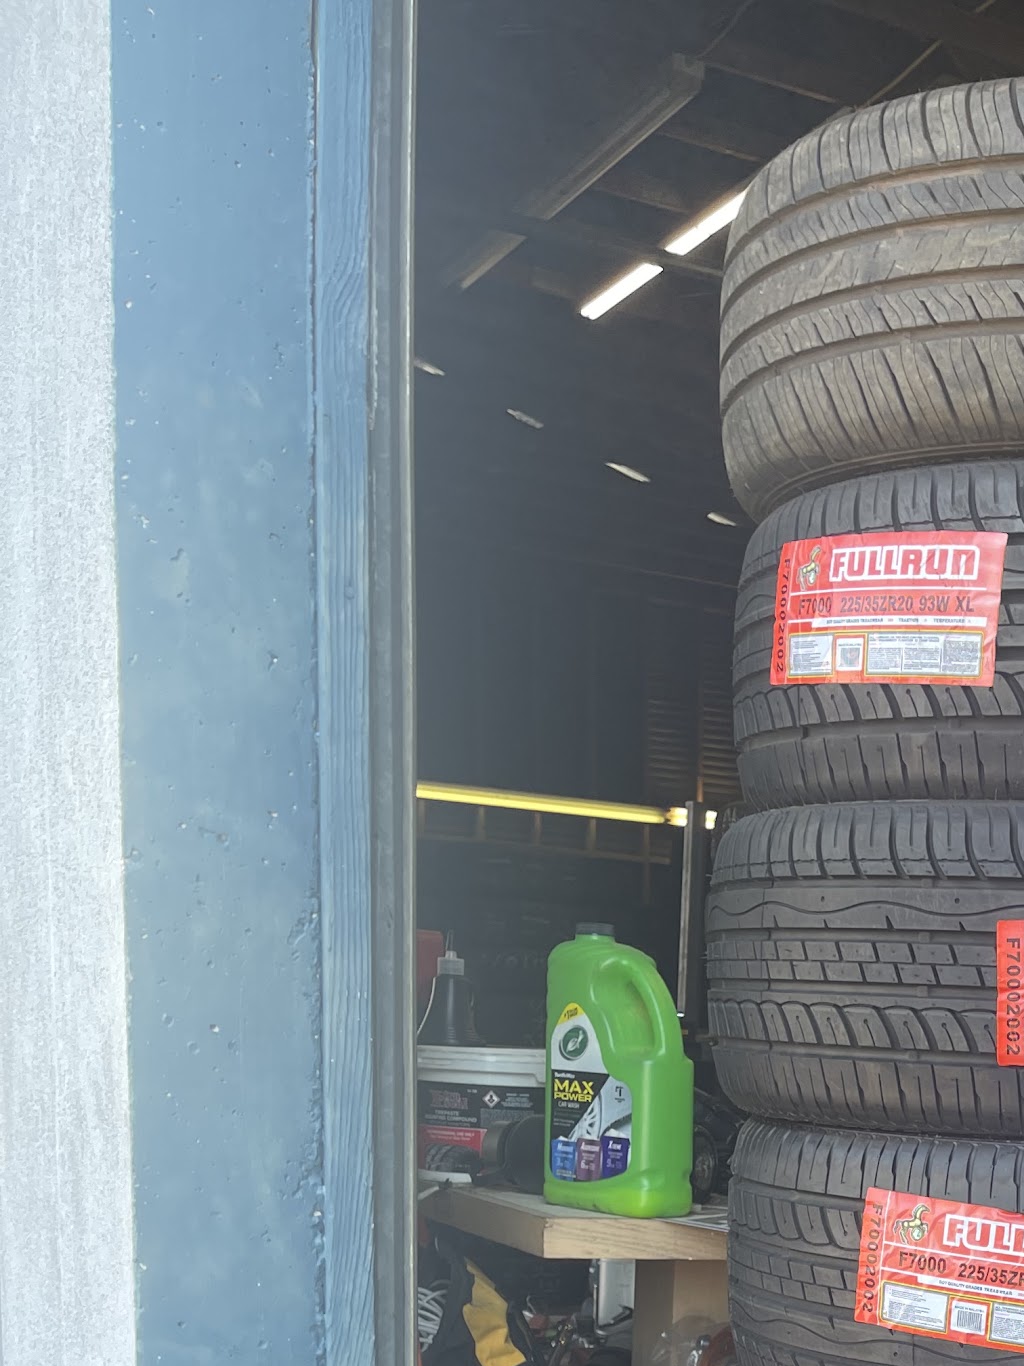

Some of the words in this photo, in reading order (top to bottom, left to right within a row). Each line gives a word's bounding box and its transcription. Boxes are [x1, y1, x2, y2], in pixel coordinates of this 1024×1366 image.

[829, 545, 980, 582] FULLRUN
[776, 558, 791, 673] F70002002
[799, 597, 832, 615] F7000
[840, 595, 913, 613] 225/35ZR20
[919, 595, 950, 612] 93W
[955, 596, 975, 612] XL
[1006, 938, 1021, 1056] F70002002
[554, 1079, 594, 1095] MAX
[554, 1092, 592, 1103] POWER
[862, 1204, 883, 1313] F70002002
[899, 1251, 947, 1275] F7000
